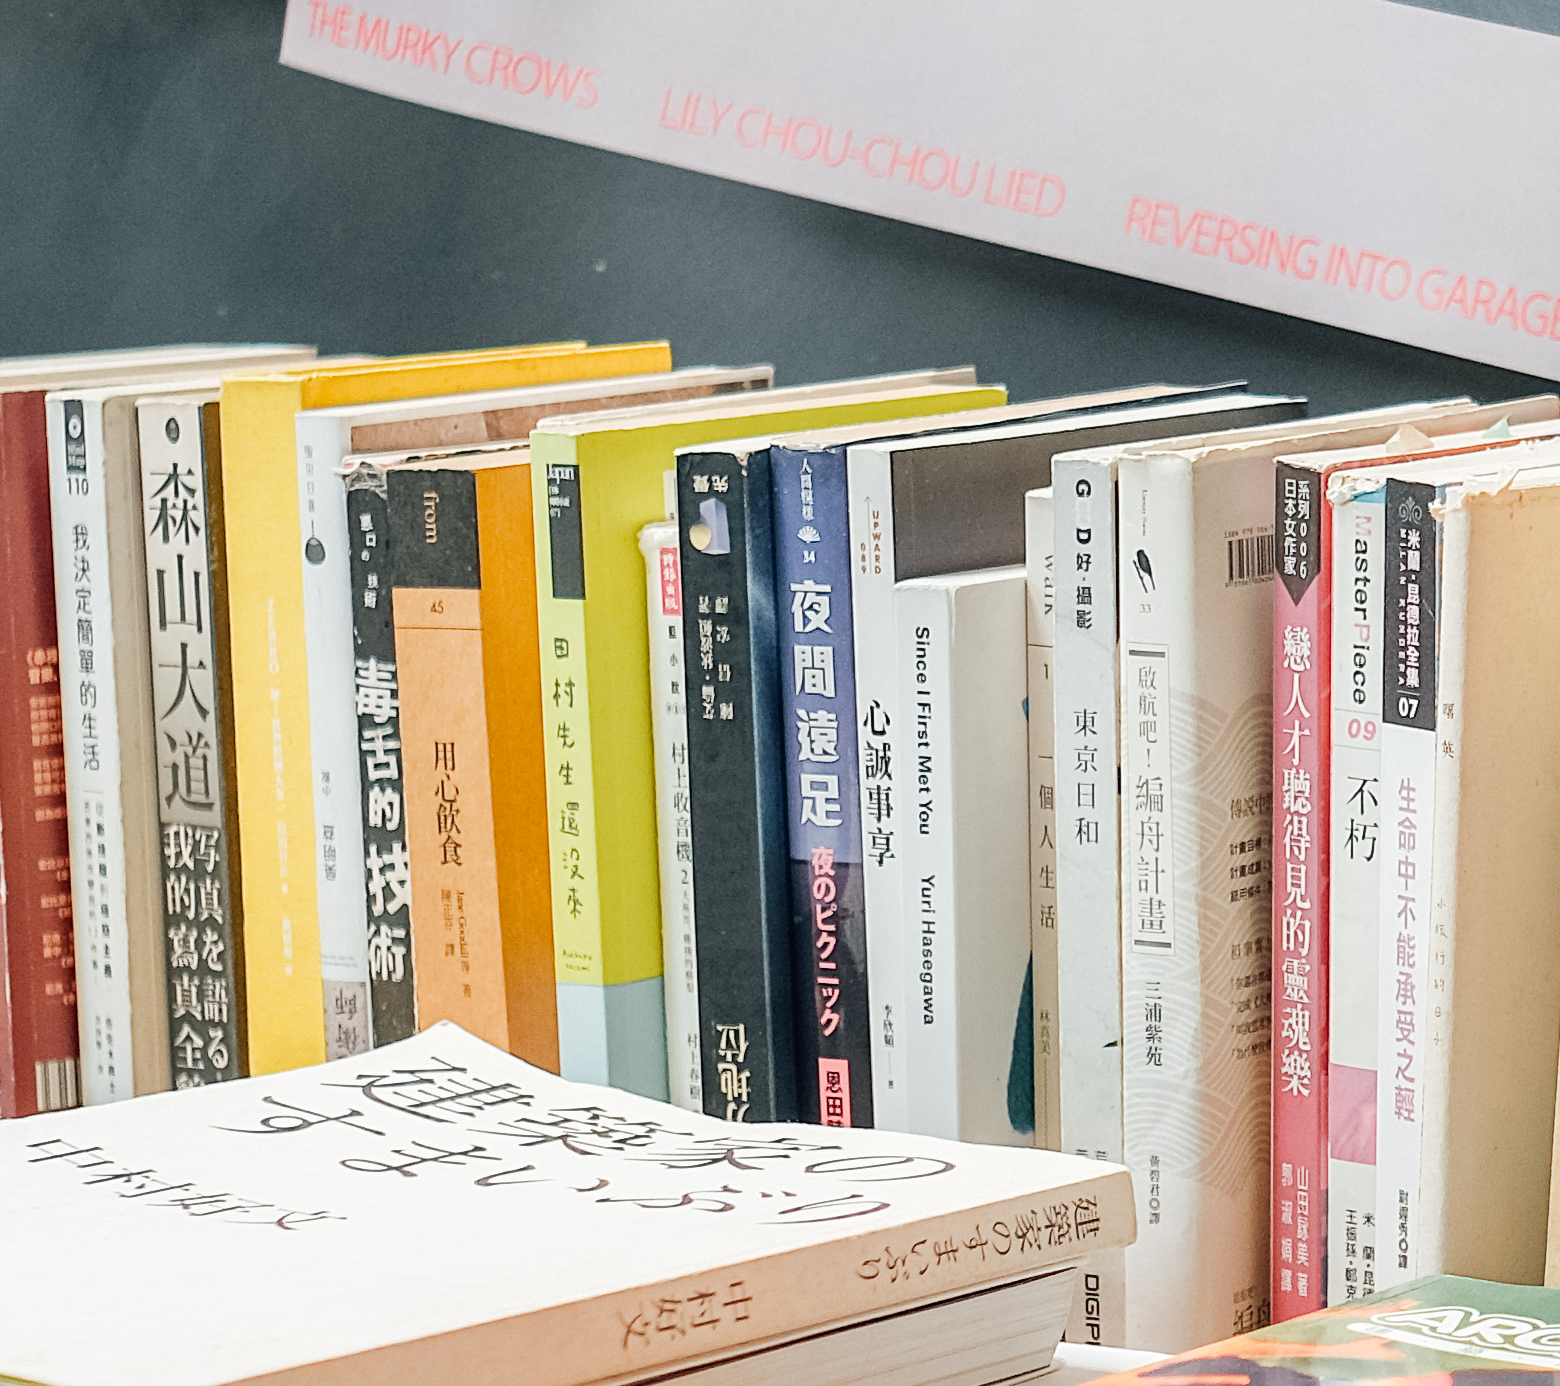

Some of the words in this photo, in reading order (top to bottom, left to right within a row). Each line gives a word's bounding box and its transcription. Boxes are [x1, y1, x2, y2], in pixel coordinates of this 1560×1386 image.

[351, 6, 464, 76] MURKY
[463, 37, 603, 113] CROWS
[657, 85, 734, 141] LILY
[732, 104, 982, 200] CHOU-CHOU
[981, 156, 1069, 221] LIED
[1122, 195, 1326, 284] REVERSING
[1321, 243, 1415, 305] INTO
[66, 477, 89, 497] 110
[423, 489, 440, 544] from
[1283, 478, 1297, 576] 日本女作家
[1297, 478, 1311, 581] 系列006
[871, 509, 883, 575] UPWARD
[71, 523, 101, 772] 我決定簡單的生活
[148, 461, 219, 814] 森山大道
[914, 624, 931, 685] Since
[790, 578, 845, 828] 夜間遠足
[916, 701, 933, 751] First
[1346, 717, 1378, 742] 09
[1397, 696, 1419, 719] 07
[353, 654, 414, 983] 毒舌的技術
[433, 740, 464, 867] 用心飲食
[552, 637, 586, 920] 田村先生還沒來
[862, 699, 897, 868] 心誠事享
[917, 754, 934, 796] Met
[917, 797, 934, 836] You
[1073, 708, 1101, 846] 東京日和
[1343, 774, 1380, 863] 不朽
[920, 873, 937, 915] Yuri
[1038, 755, 1056, 930] 一個人生活
[1281, 625, 1312, 1098] 戀人才聽得見的靈魂樂
[194, 827, 230, 1069] 写真を語る
[809, 845, 842, 1038] 夜のピクニック
[919, 919, 937, 1027] Hasegawa
[1394, 776, 1419, 1124] 生命中不能承受之輕
[1144, 981, 1163, 1067] 三浦紫苑
[322, 1054, 958, 1185] 建築家の
[826, 1070, 844, 1126] 恩田
[24, 1135, 350, 1232] 中村好文
[226, 1093, 894, 1225] すまいぶり
[854, 1193, 1101, 1285] 建築家のすまいぶり
[618, 1279, 754, 1349] 中村好文
[1084, 1273, 1101, 1345] DIGIP
